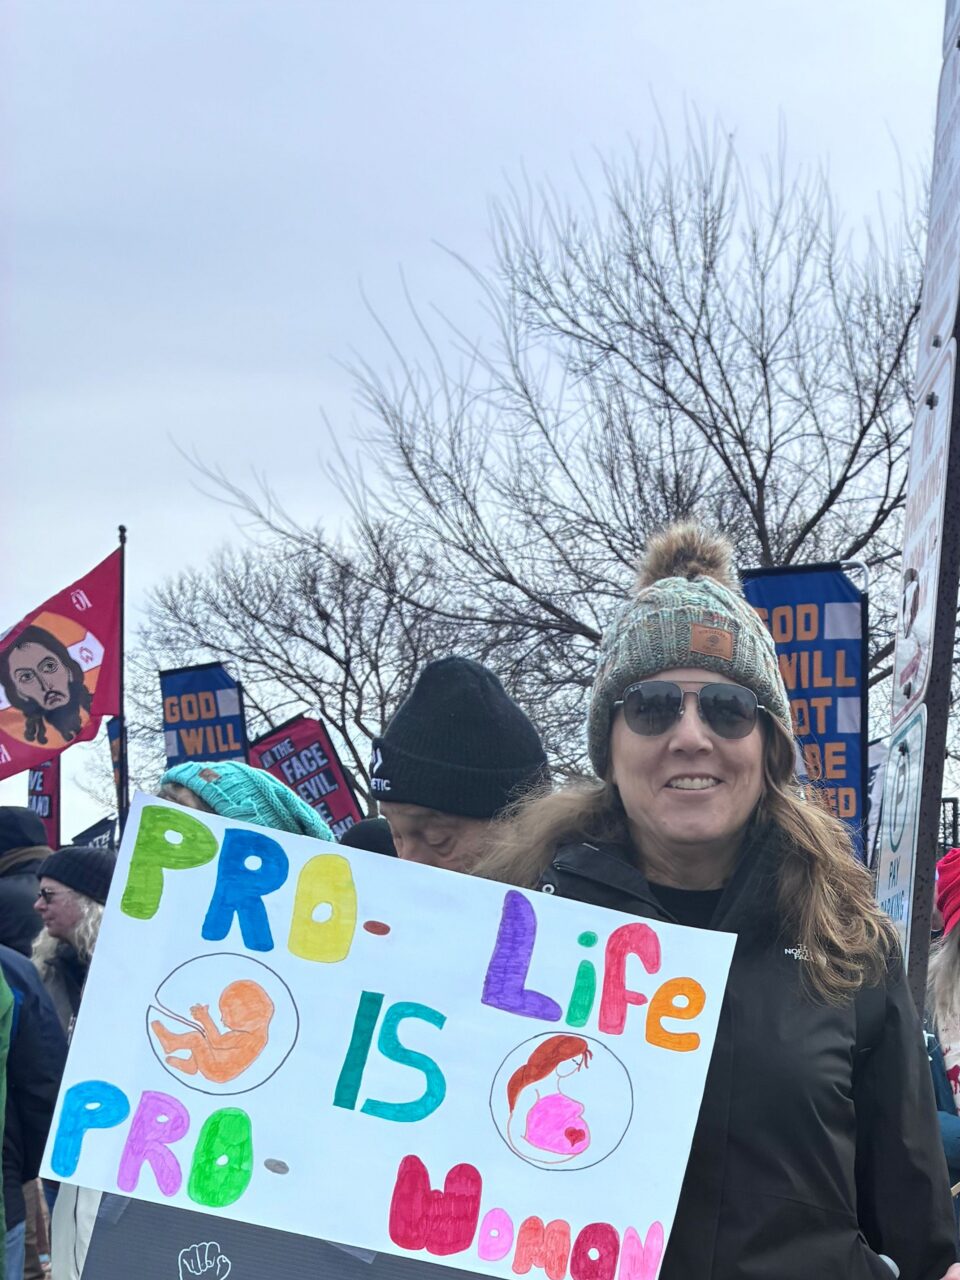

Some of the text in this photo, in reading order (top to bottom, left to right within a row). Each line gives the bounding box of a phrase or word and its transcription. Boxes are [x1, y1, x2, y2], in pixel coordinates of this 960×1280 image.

[163, 691, 216, 724] GOD
[791, 696, 832, 736] OT
[179, 723, 242, 756] WILL
[271, 738, 295, 760] THE
[280, 742, 329, 784] FACE
[804, 742, 847, 781] BE
[297, 772, 339, 804] EVIL
[120, 805, 391, 963] PRO-
[332, 990, 448, 1122] IS
[50, 1080, 291, 1208] PRO-
